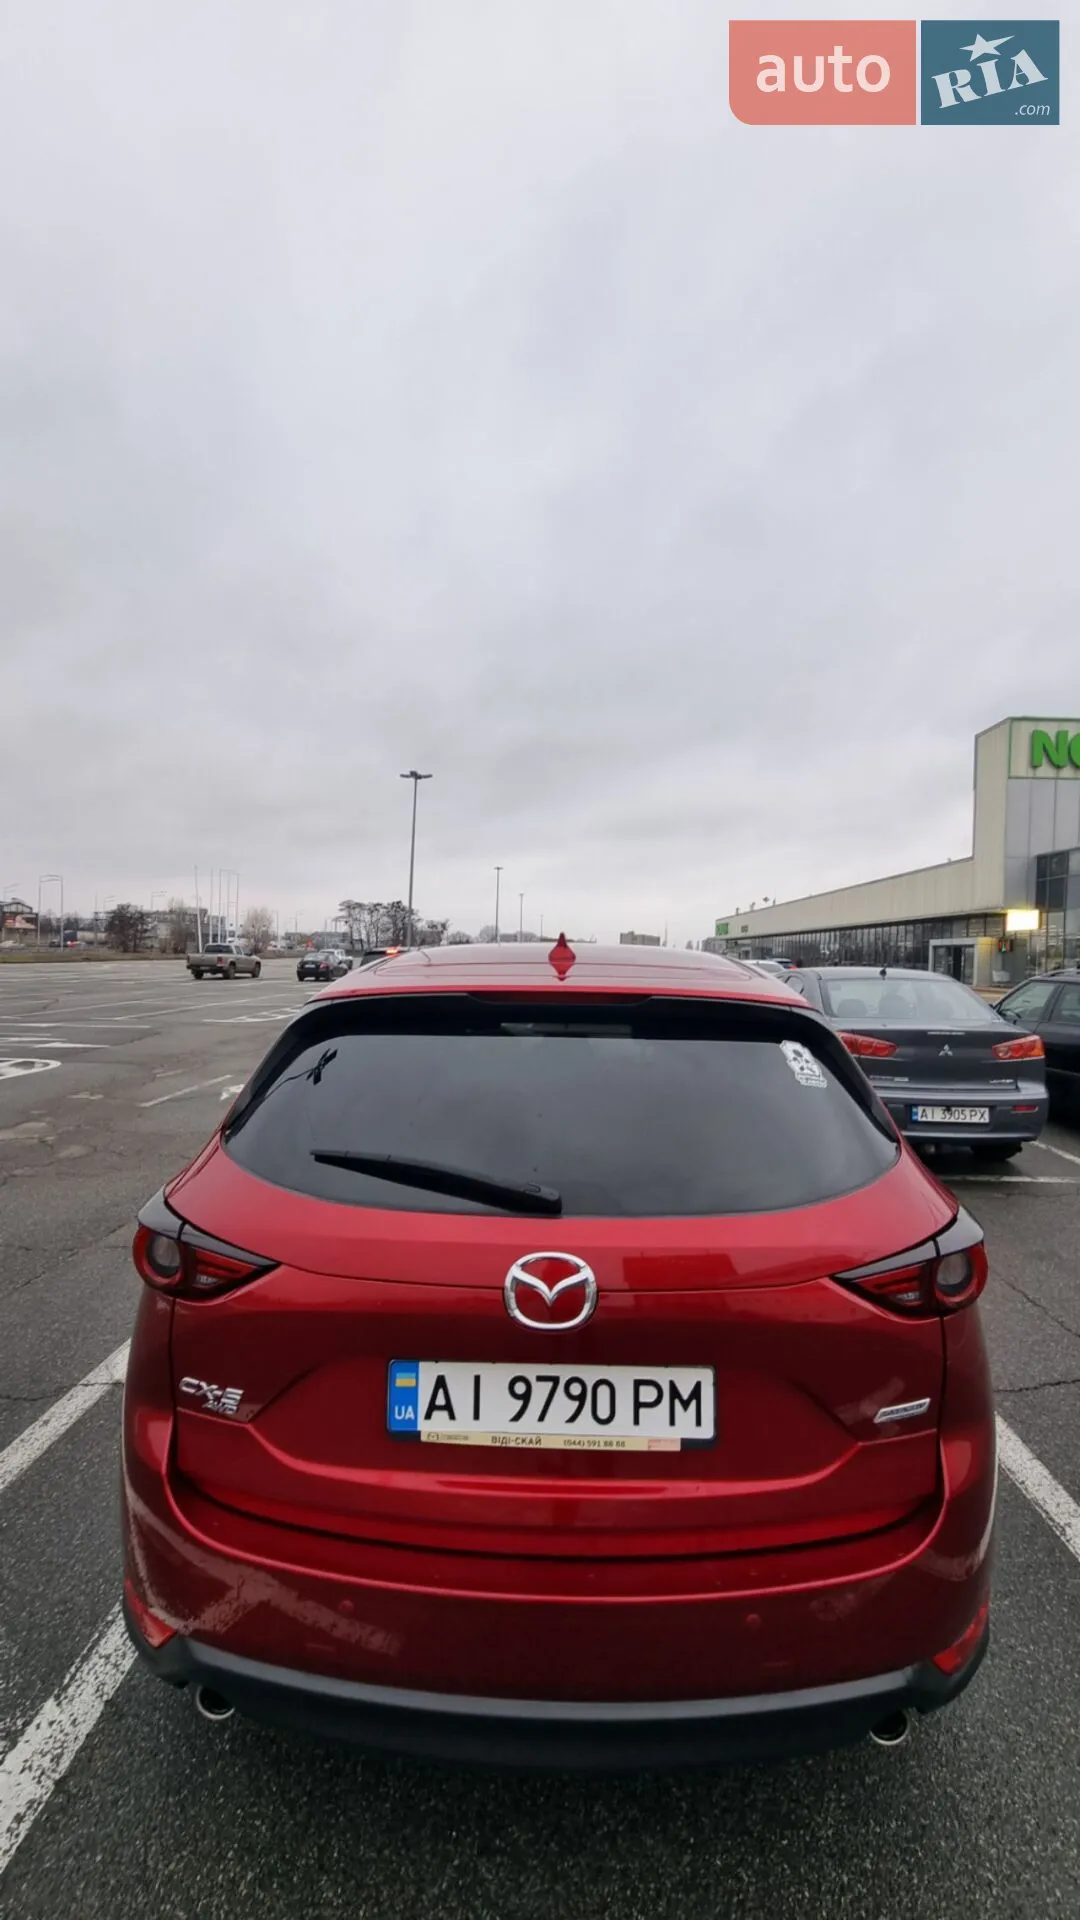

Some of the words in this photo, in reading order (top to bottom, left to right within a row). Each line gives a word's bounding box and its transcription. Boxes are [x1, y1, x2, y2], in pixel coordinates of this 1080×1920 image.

[920, 1108, 935, 1120] AI
[969, 1109, 987, 1121] PX
[180, 1377, 244, 1406] CX-5
[424, 1374, 481, 1421] AI
[507, 1375, 616, 1425] 9790
[633, 1379, 702, 1427] PM
[394, 1405, 415, 1420] UA
